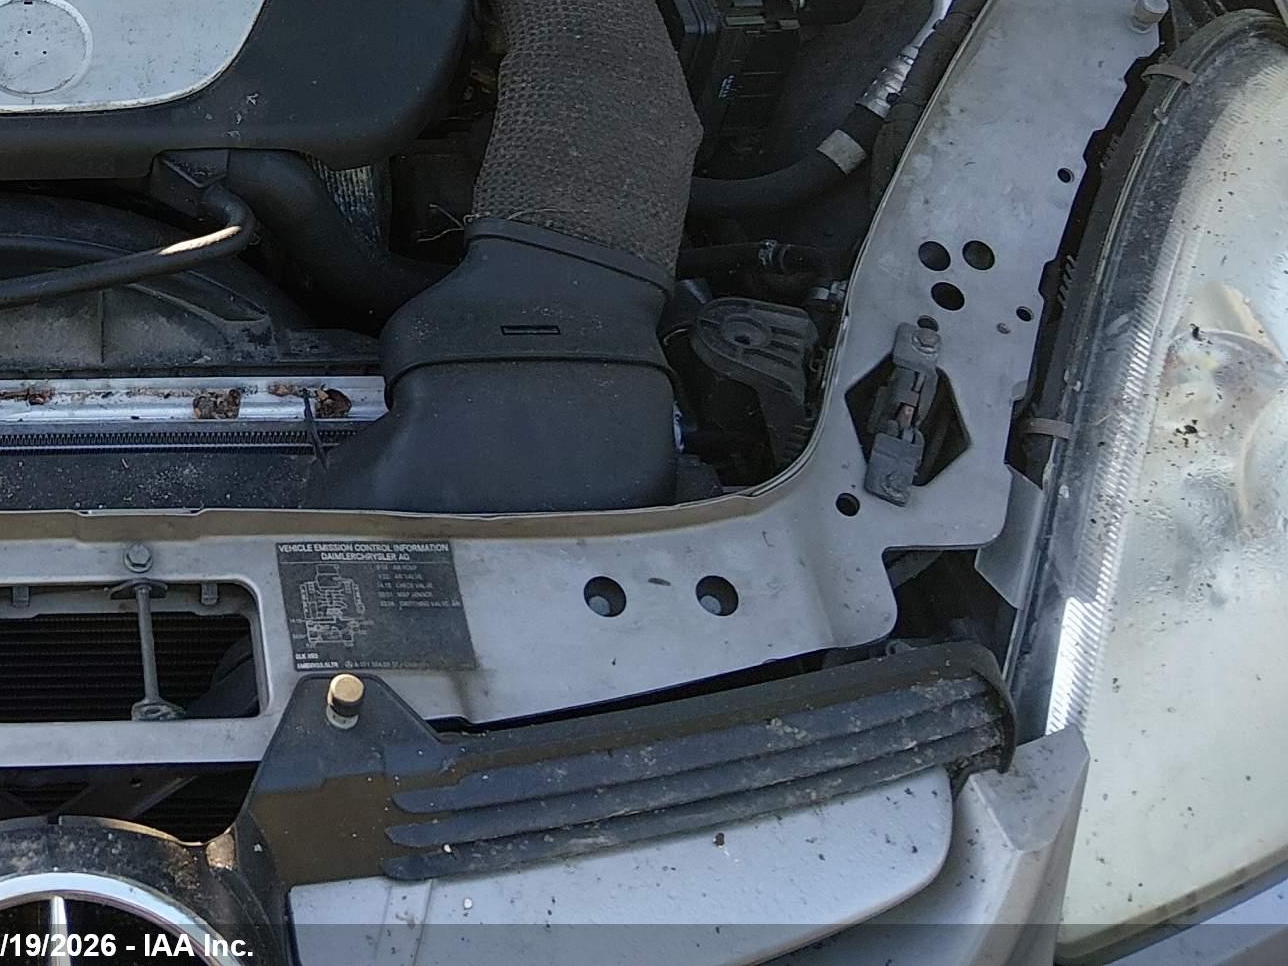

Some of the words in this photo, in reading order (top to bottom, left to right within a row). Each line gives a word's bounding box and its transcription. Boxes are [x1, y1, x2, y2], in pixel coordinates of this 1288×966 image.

[278, 544, 313, 553] VEHICLE
[314, 543, 353, 552] EMISSION
[354, 543, 393, 552] CONTROL
[393, 543, 449, 552] INFORMATION
[320, 552, 397, 561] DAIMLERCHRYSLER
